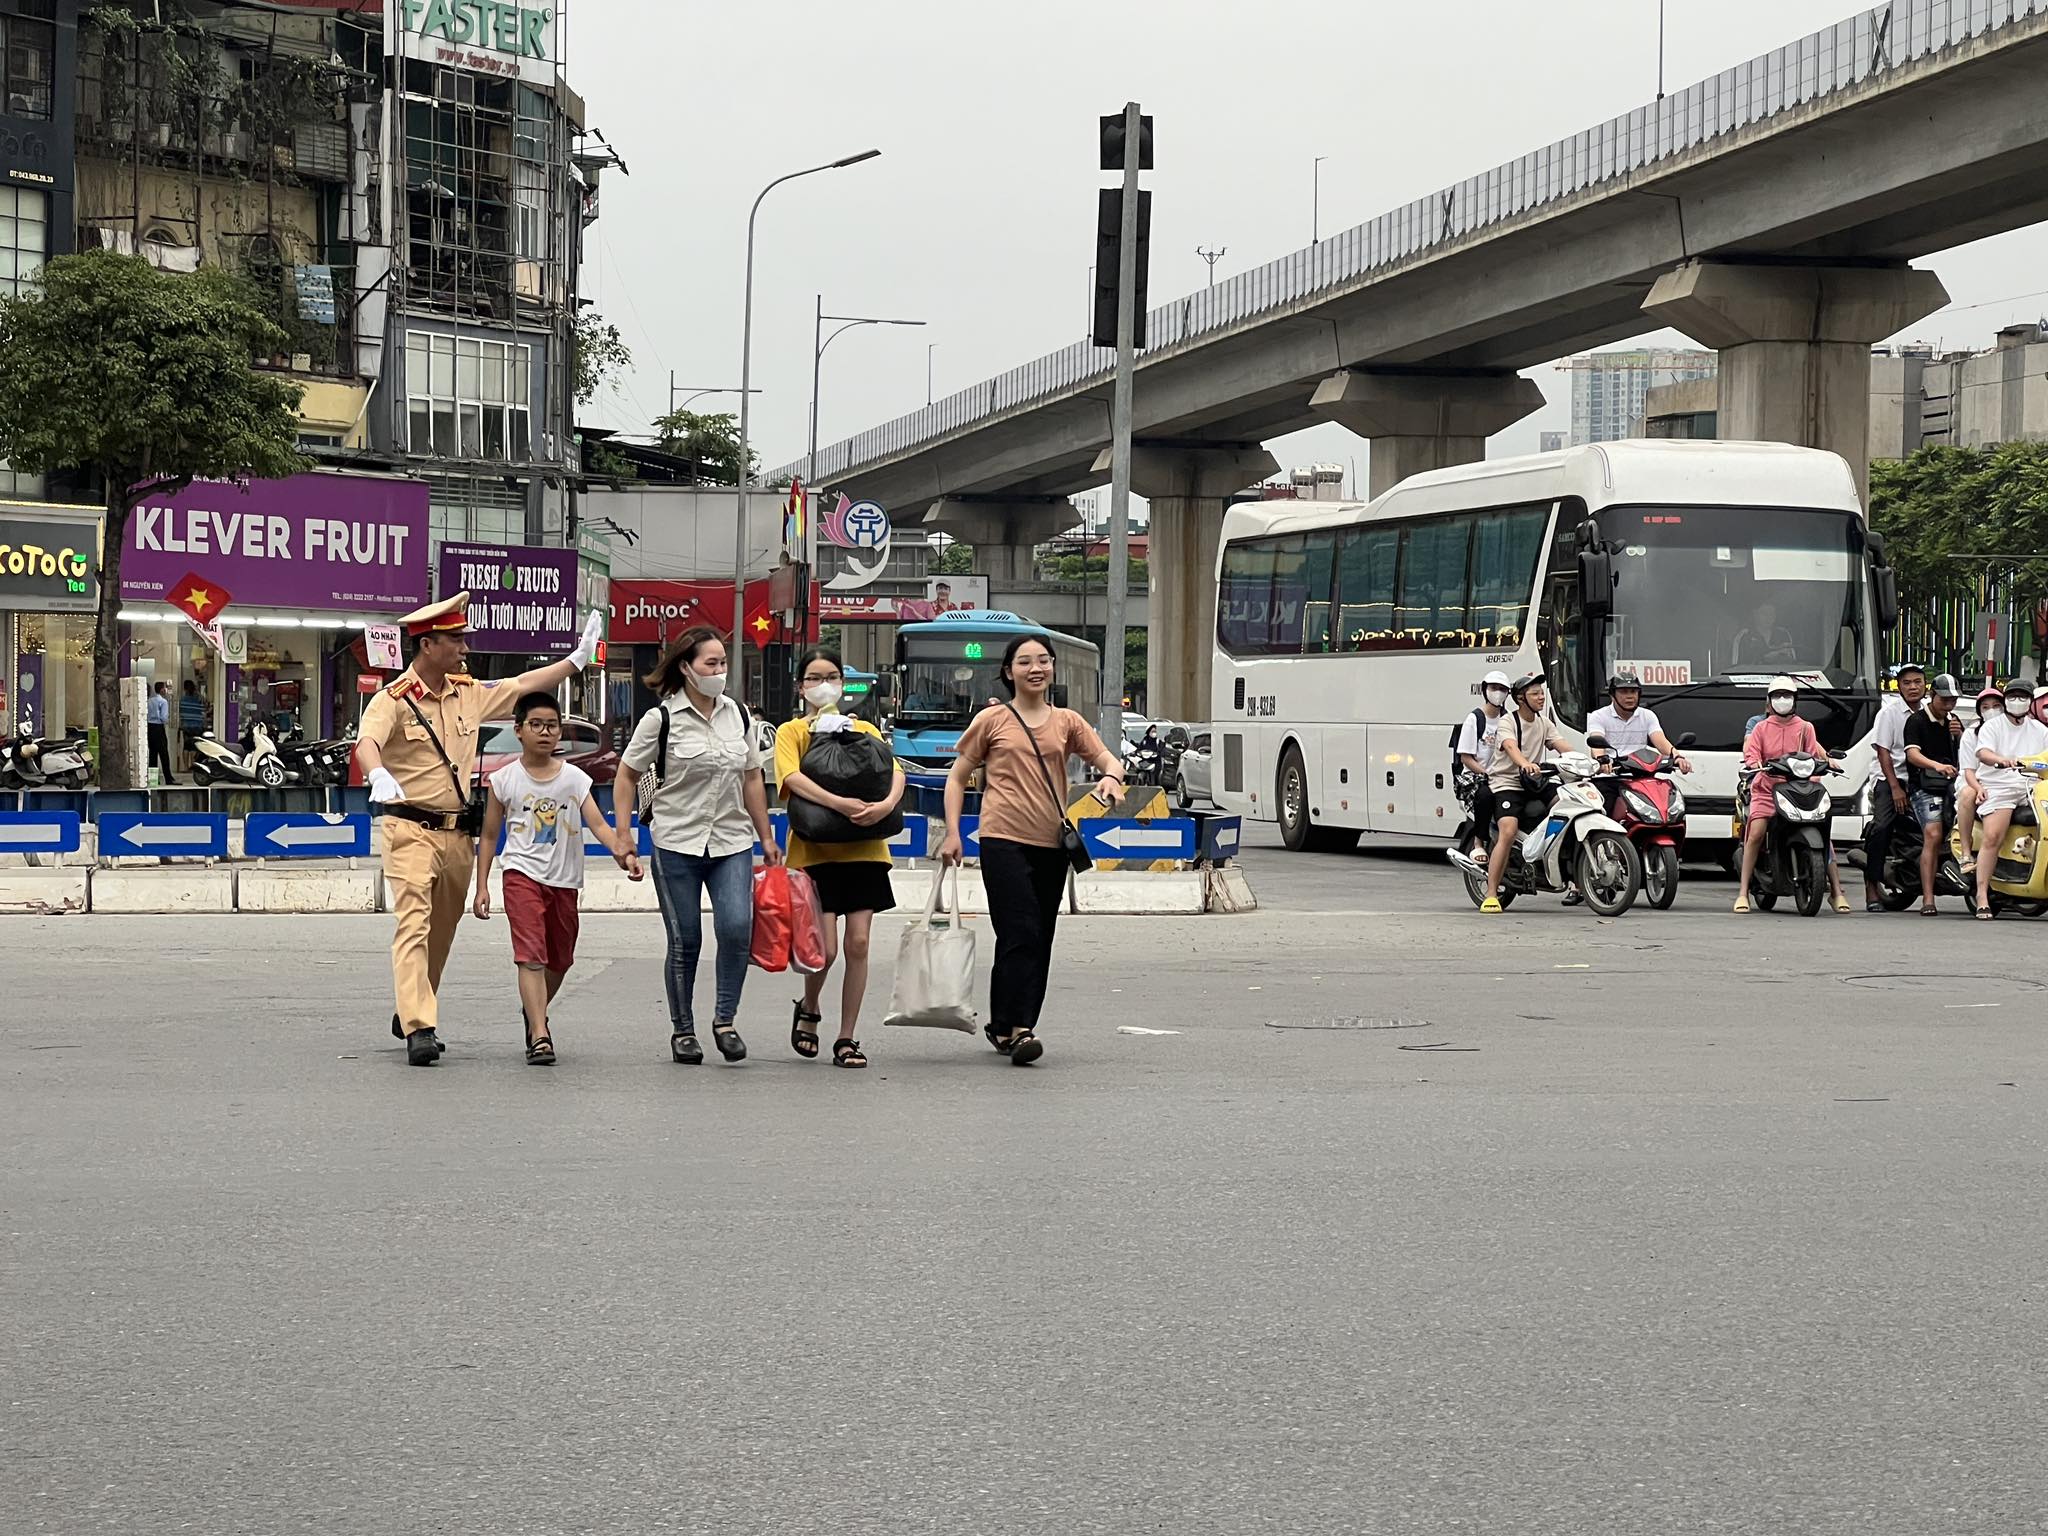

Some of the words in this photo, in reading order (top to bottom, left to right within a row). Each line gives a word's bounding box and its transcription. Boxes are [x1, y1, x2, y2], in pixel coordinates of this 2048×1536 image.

[135, 505, 292, 560] KLEVER
[304, 517, 409, 566] FRUIT
[66, 578, 86, 593] Tea
[460, 563, 500, 590] FRESH
[516, 566, 560, 593] FRUITS
[516, 600, 544, 637] NHẬP
[545, 597, 572, 632] KHẨU
[1643, 661, 1688, 685] ĐÔNG
